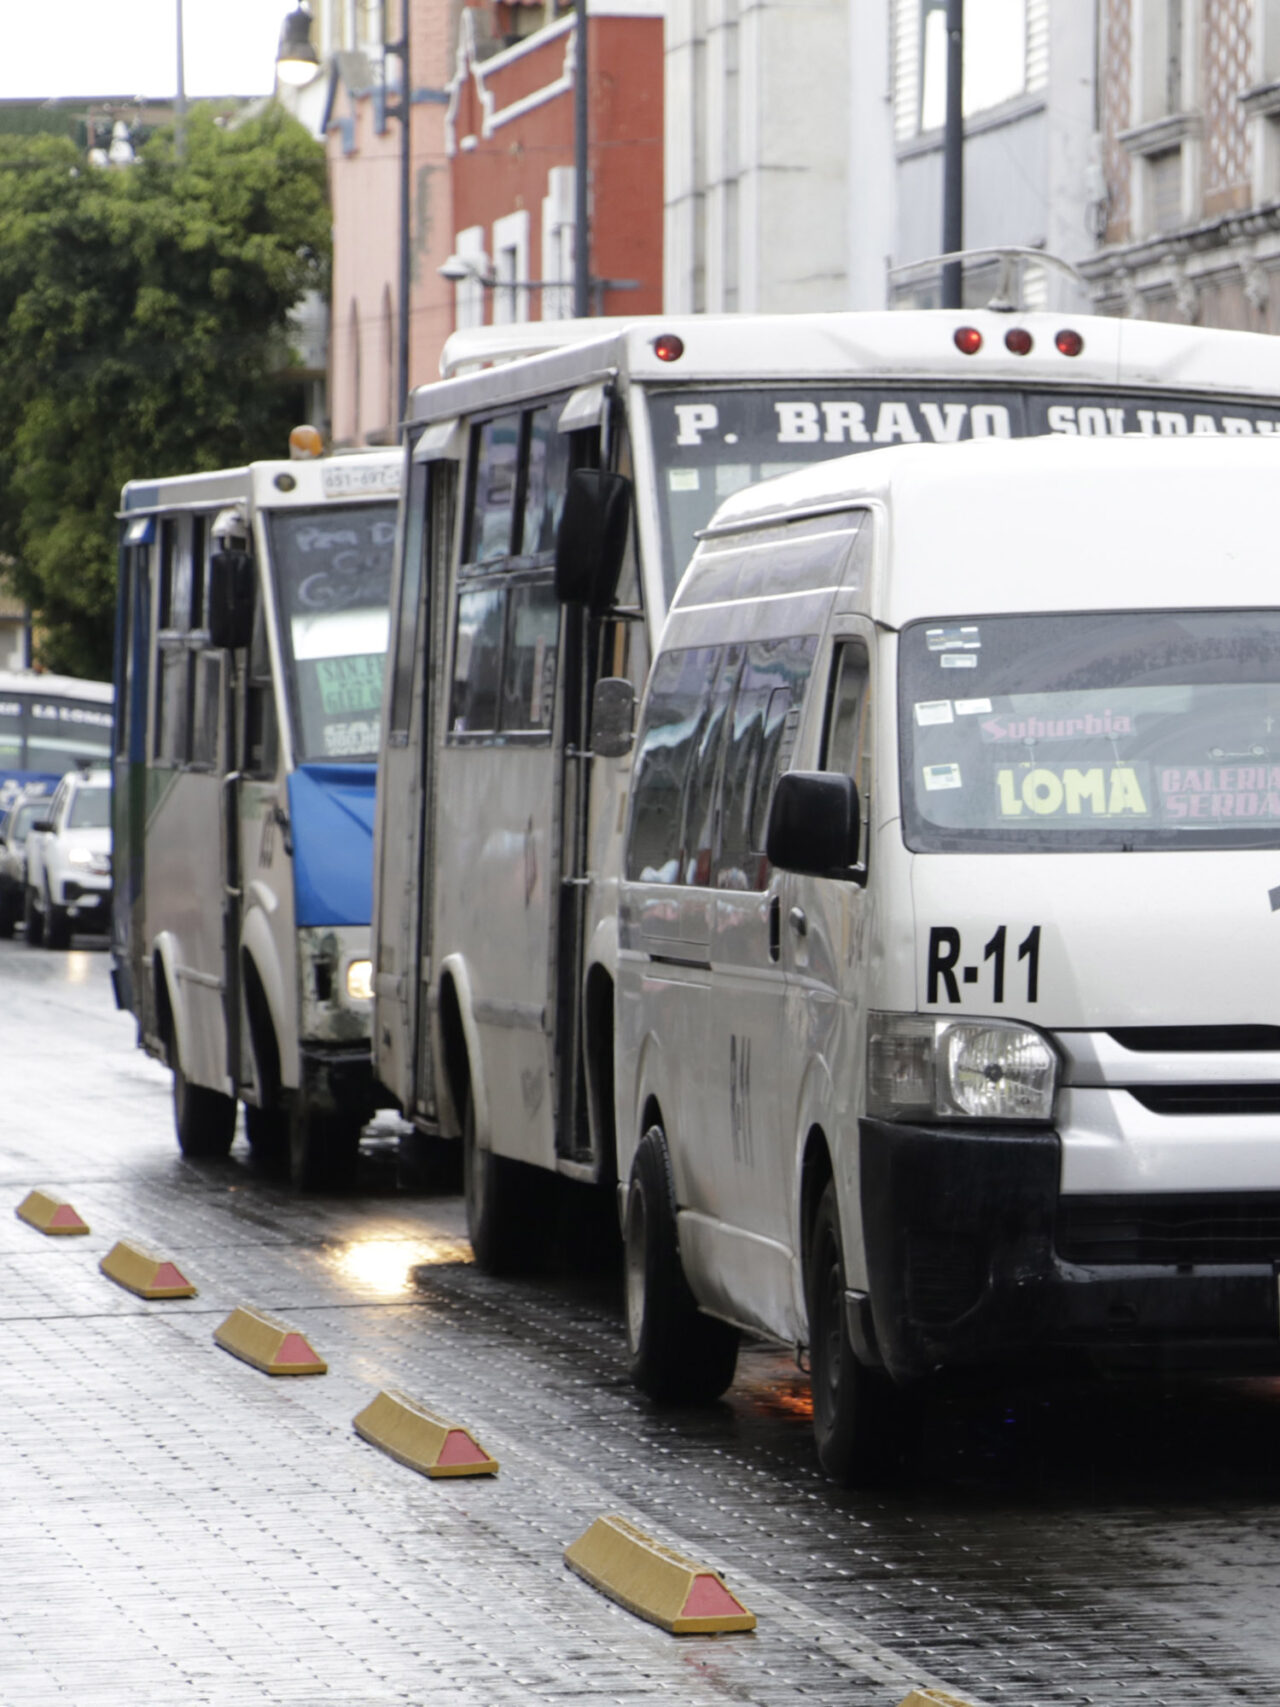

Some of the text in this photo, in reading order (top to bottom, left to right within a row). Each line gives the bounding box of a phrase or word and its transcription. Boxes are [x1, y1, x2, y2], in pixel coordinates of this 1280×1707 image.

[674, 403, 739, 446] P.
[774, 400, 1012, 443] BRAVO
[996, 766, 1148, 816] LOMA
[927, 924, 1042, 1005] R-11
